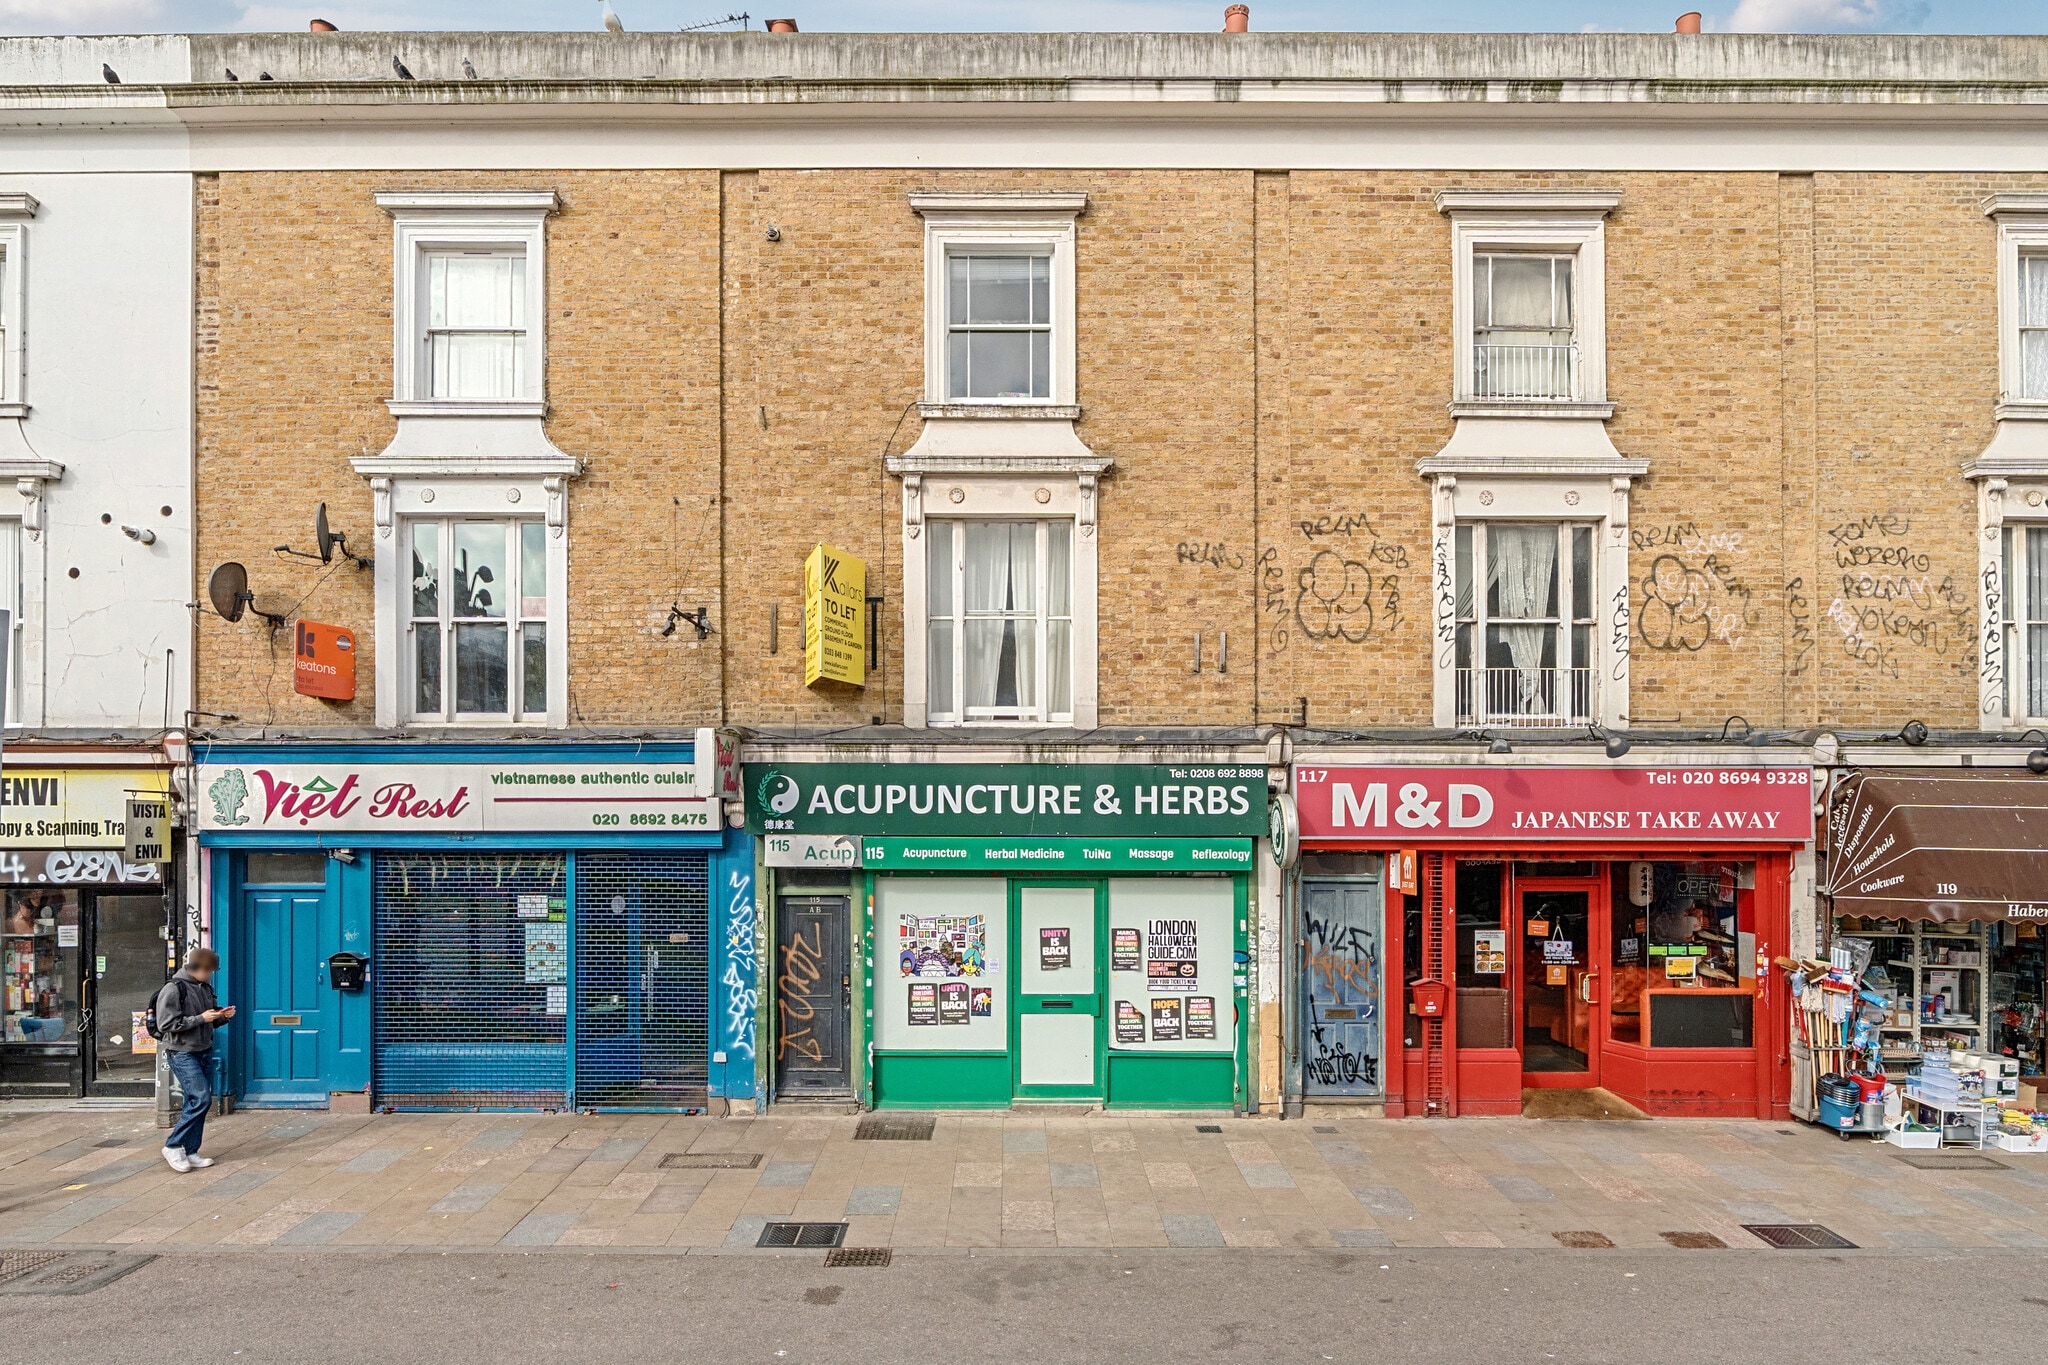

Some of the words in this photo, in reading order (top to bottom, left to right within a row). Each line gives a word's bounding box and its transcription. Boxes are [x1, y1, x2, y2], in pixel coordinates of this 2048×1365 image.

[824, 598, 838, 615] TO
[840, 603, 857, 621] LET
[824, 633, 844, 645] BASEMENT
[296, 658, 337, 675] keatons
[491, 771, 576, 785] vietnamese
[580, 771, 649, 785] authentic
[1169, 768, 1188, 779] Tel:
[1190, 769, 1215, 779] 0208
[1217, 769, 1237, 779] 692
[1239, 769, 1264, 779] 8898
[1299, 770, 1328, 783] 117
[1647, 772, 1677, 785] Tel:
[1682, 773, 1714, 785] 020
[1719, 773, 1761, 785] 8694
[1766, 773, 1808, 785] 9328
[2, 778, 58, 806] ENVI
[368, 783, 470, 818] Rest
[807, 784, 1082, 815] ACUPUNCTURE
[1093, 784, 1122, 815] &
[1134, 785, 1250, 815] HERBS
[1332, 782, 1494, 829] M&D
[132, 803, 166, 818] VISTA
[592, 813, 620, 826] 020
[629, 813, 666, 826] 8692
[671, 813, 708, 826] 8475
[1511, 811, 1630, 829] JAPANESE
[1637, 811, 1701, 829] TAKE
[1707, 811, 1780, 829] AWAY
[25, 820, 34, 836] &
[37, 819, 102, 838] Scanning.
[104, 820, 127, 836] Tra
[145, 826, 154, 838] &
[1843, 804, 1874, 859] Disposable
[135, 844, 163, 860] ENVI
[769, 839, 790, 852] 115
[866, 847, 885, 860] 115
[903, 847, 967, 859] Acupuncture
[985, 848, 1017, 859] Herbal
[1020, 848, 1065, 859] Medicine
[1083, 848, 1111, 860] TuiNa
[1129, 848, 1174, 861] Massage
[1192, 849, 1250, 862] Reflexology
[1852, 833, 1897, 876] Household
[1677, 880, 1720, 896] OPEN
[1860, 874, 1906, 893] Cookware
[1936, 883, 1958, 895] 119
[809, 896, 821, 904] 115
[1042, 929, 1068, 938] UNITY
[1148, 920, 1197, 935] LONDON
[1050, 937, 1060, 946] IS
[1148, 936, 1197, 946] HALLOWEEN
[1042, 946, 1068, 956] BACK
[1148, 947, 1197, 959] GUIDE.COM
[941, 984, 967, 992] UNITY
[950, 992, 959, 1001] IS
[942, 1001, 967, 1010] BACK
[1153, 1000, 1179, 1009] HOPE
[1162, 1009, 1171, 1018] IS
[1153, 1018, 1180, 1028] BACK
